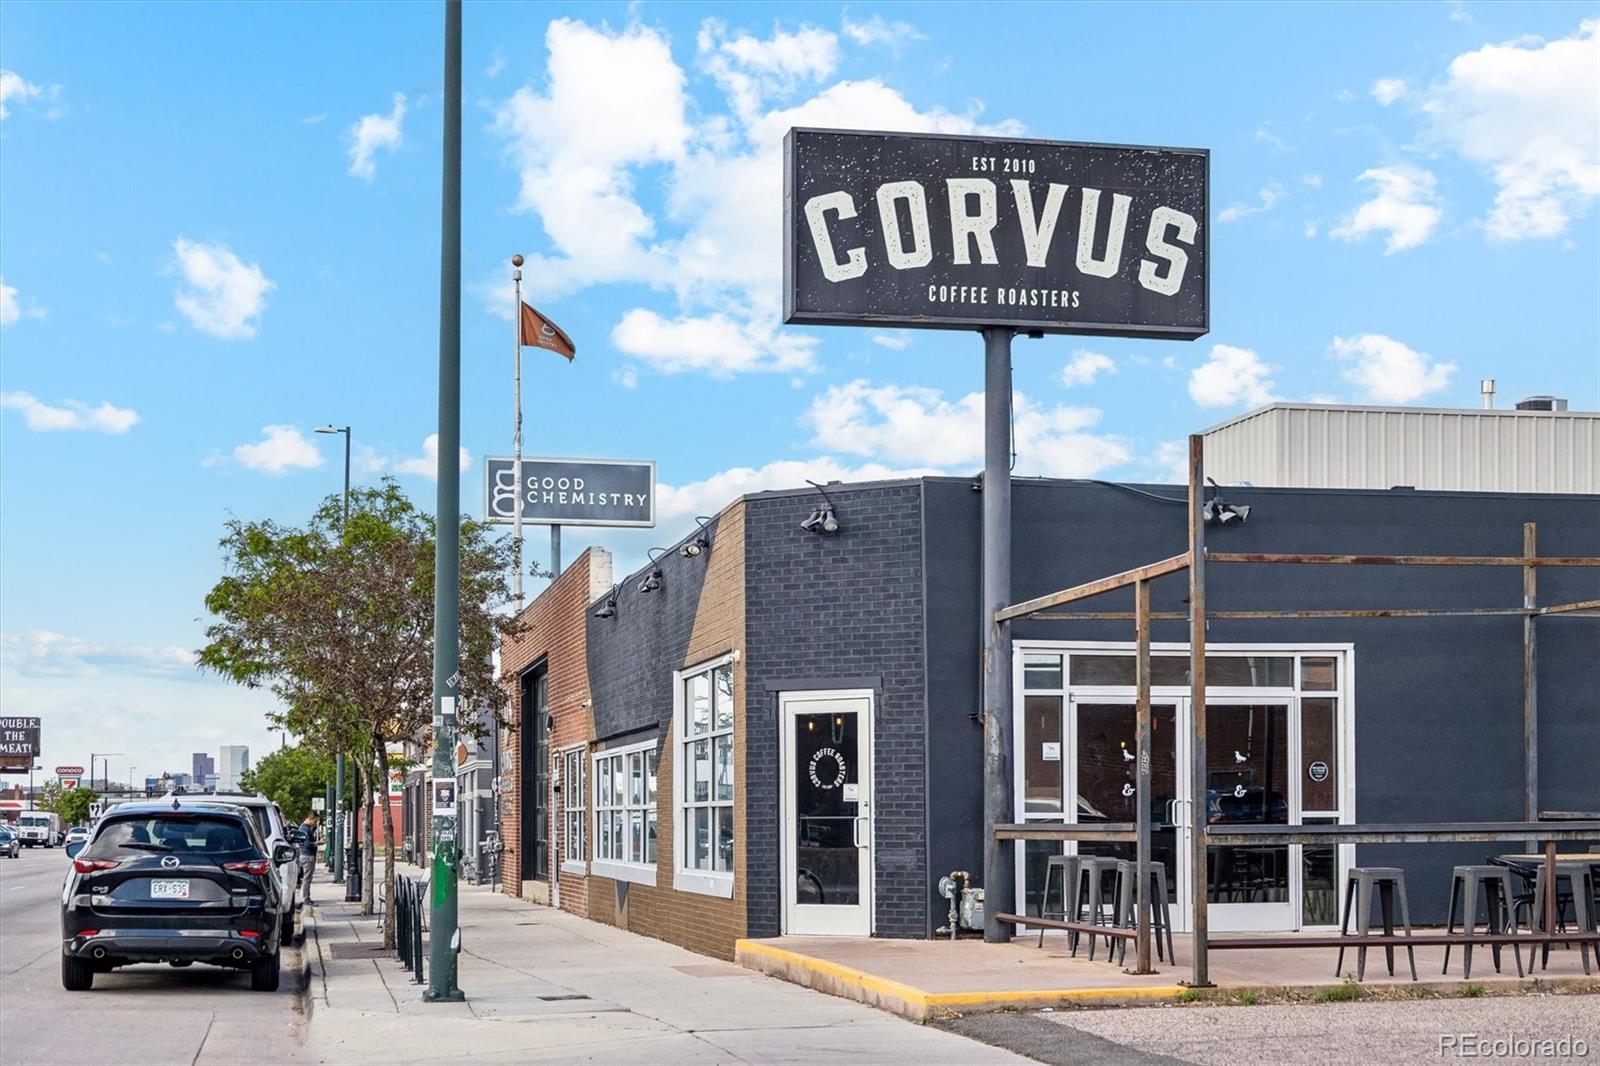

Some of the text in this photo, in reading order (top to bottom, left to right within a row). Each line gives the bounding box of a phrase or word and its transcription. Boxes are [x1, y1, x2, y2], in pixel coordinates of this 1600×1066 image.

[972, 157, 1035, 173] EST 2010
[804, 178, 1198, 296] CORVUS
[928, 285, 1080, 307] COFFEE ROASTERS
[527, 477, 585, 490] GOOD
[527, 491, 647, 506] CHEMISTRY
[0, 718, 36, 729] OUBLE
[4, 731, 25, 741] THE
[813, 748, 835, 761] COFFEE
[809, 761, 821, 787] CORVUS
